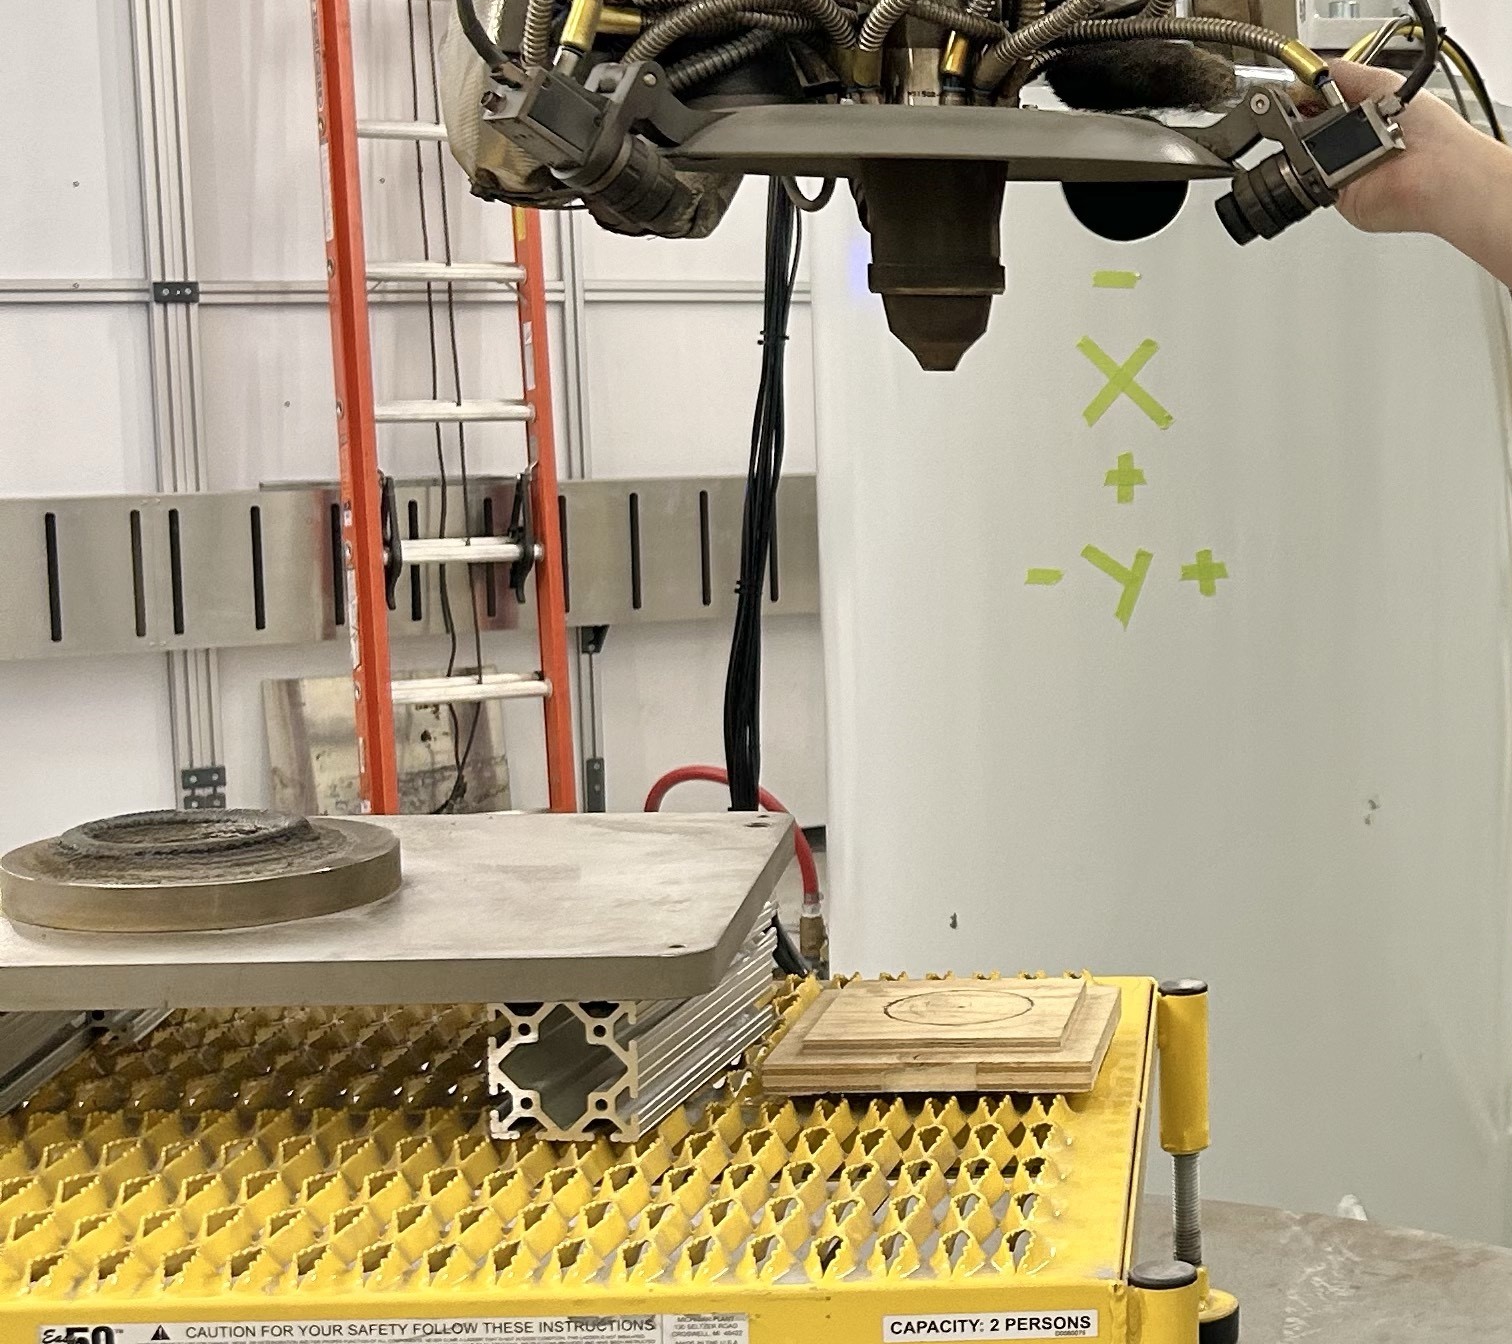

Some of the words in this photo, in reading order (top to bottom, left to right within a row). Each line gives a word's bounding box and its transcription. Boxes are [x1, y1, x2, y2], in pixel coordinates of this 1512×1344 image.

[186, 1324, 256, 1339] CAUTION
[261, 1324, 294, 1338] FOR
[297, 1323, 344, 1337] YOUR
[347, 1323, 408, 1336] SAFETY
[412, 1322, 479, 1336] FOLLOW
[482, 1321, 534, 1335] THESE
[538, 1319, 656, 1334] INSTRUCTIONS
[890, 1318, 985, 1335] CAPACITY:
[989, 1318, 1000, 1332] 2
[1005, 1315, 1092, 1332] PERSONS
